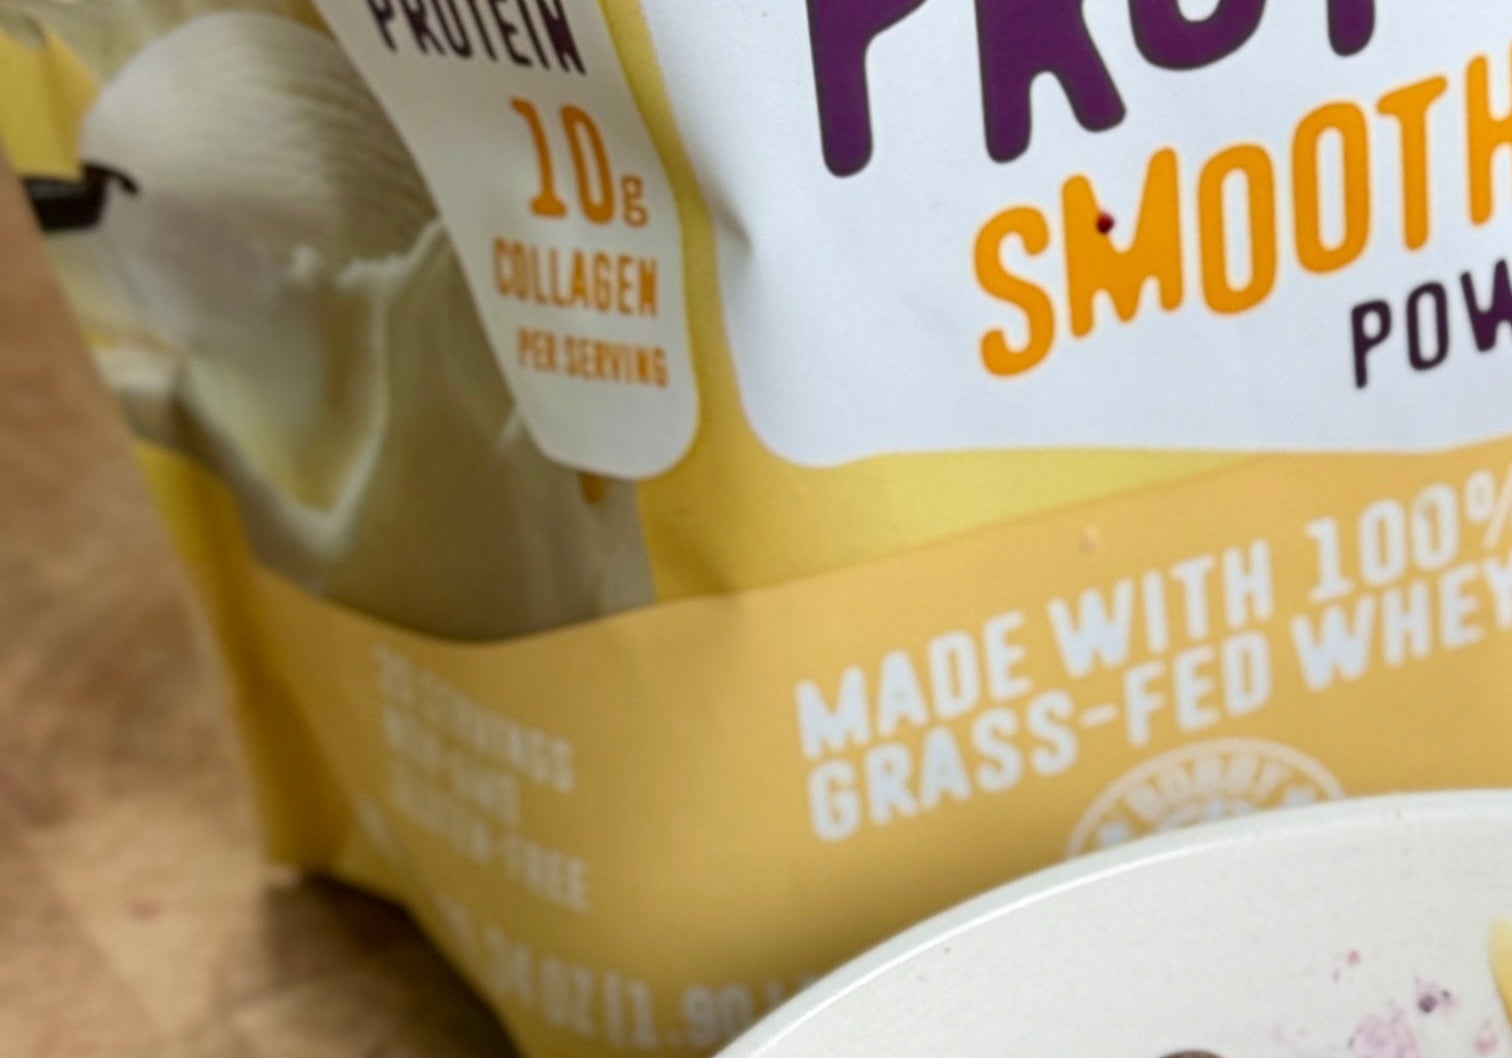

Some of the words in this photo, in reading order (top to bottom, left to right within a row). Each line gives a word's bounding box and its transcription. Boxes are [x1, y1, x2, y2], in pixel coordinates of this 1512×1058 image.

[368, 0, 586, 75] PROTEIN
[510, 98, 649, 227] 10g
[492, 237, 658, 318] COLLAGEN
[517, 327, 559, 375] PER
[563, 334, 670, 389] SERVING
[794, 611, 1034, 763] MADE
[1046, 538, 1275, 680] WITH
[806, 632, 1275, 843] GRASS-FED
